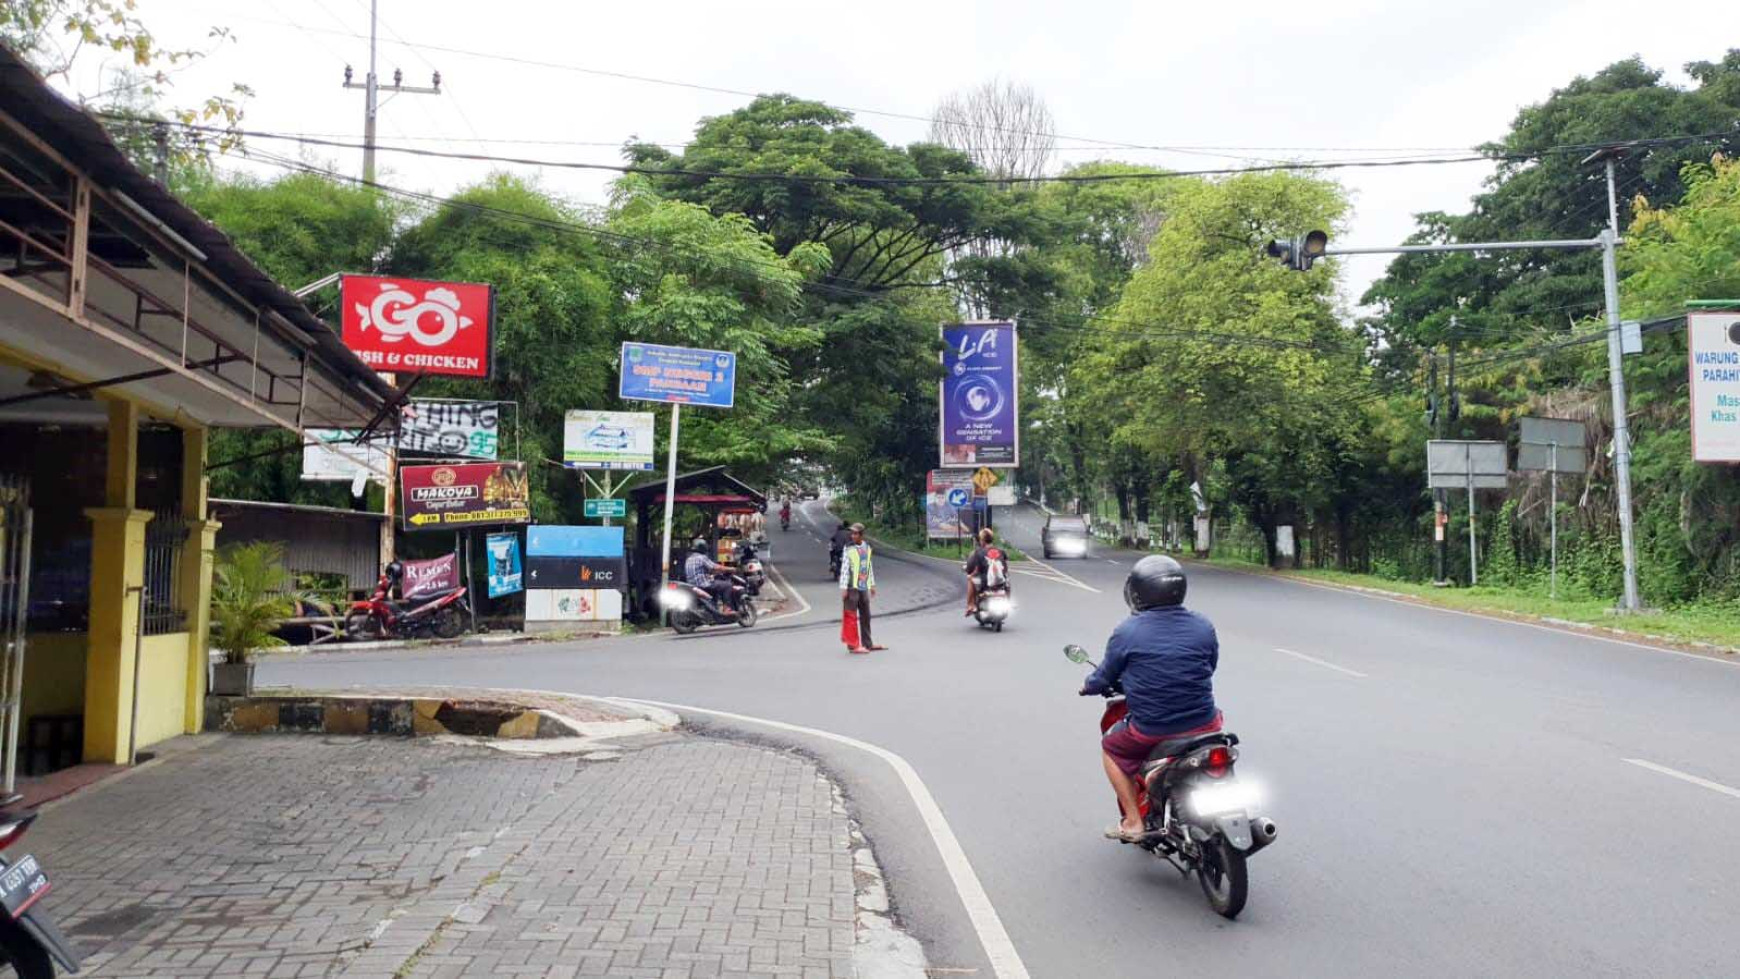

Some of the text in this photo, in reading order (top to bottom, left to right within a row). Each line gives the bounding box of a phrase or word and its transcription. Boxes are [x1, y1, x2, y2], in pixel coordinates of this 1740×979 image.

[387, 352, 400, 364] &
[404, 354, 478, 369] CHICKEN
[1695, 352, 1738, 364] WARUNG
[1712, 410, 1737, 422] Khas
[417, 488, 472, 499] MAKOYA
[595, 571, 613, 580] ICC
